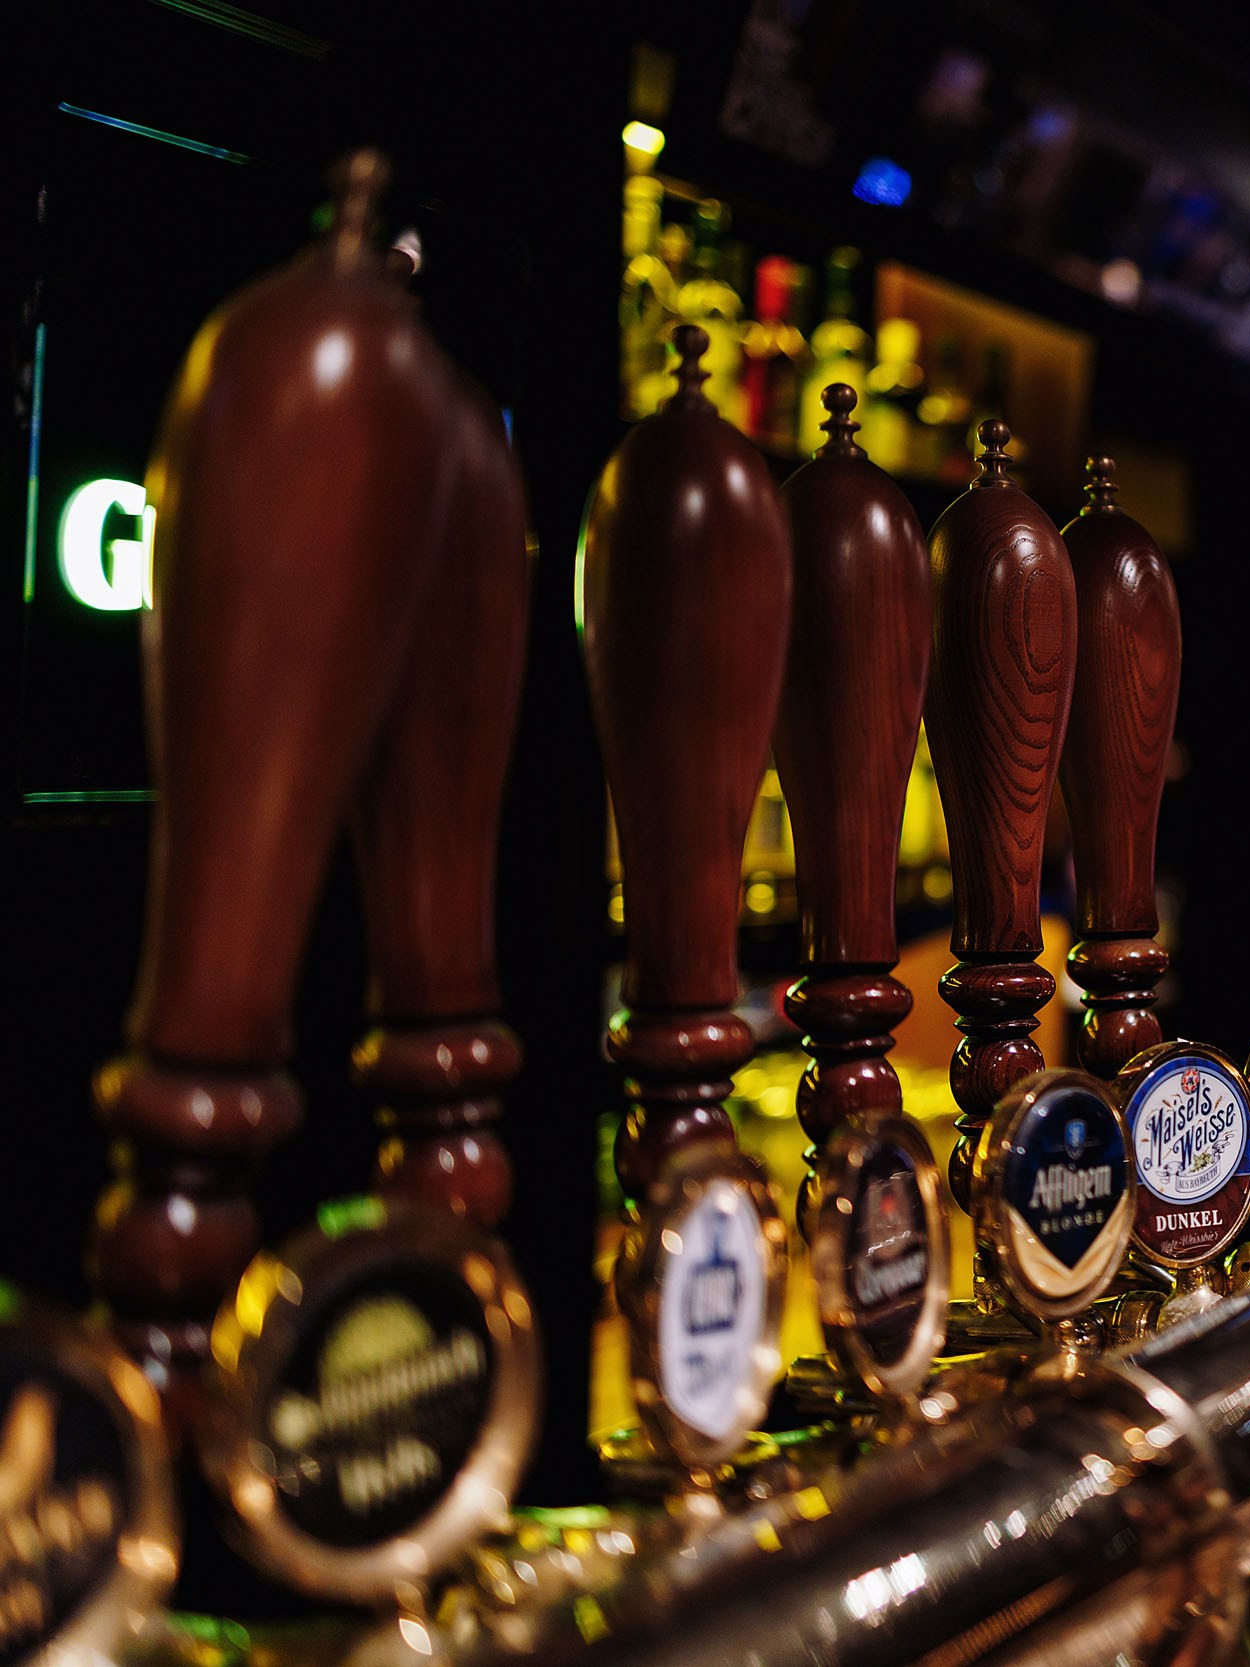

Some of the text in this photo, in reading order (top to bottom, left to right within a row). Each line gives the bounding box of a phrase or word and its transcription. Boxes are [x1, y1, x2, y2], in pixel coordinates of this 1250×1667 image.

[57, 478, 156, 611] G
[1143, 1079, 1212, 1170] Maisel's
[1173, 1103, 1235, 1171] Weisse
[1155, 1209, 1224, 1233] DUNKEL
